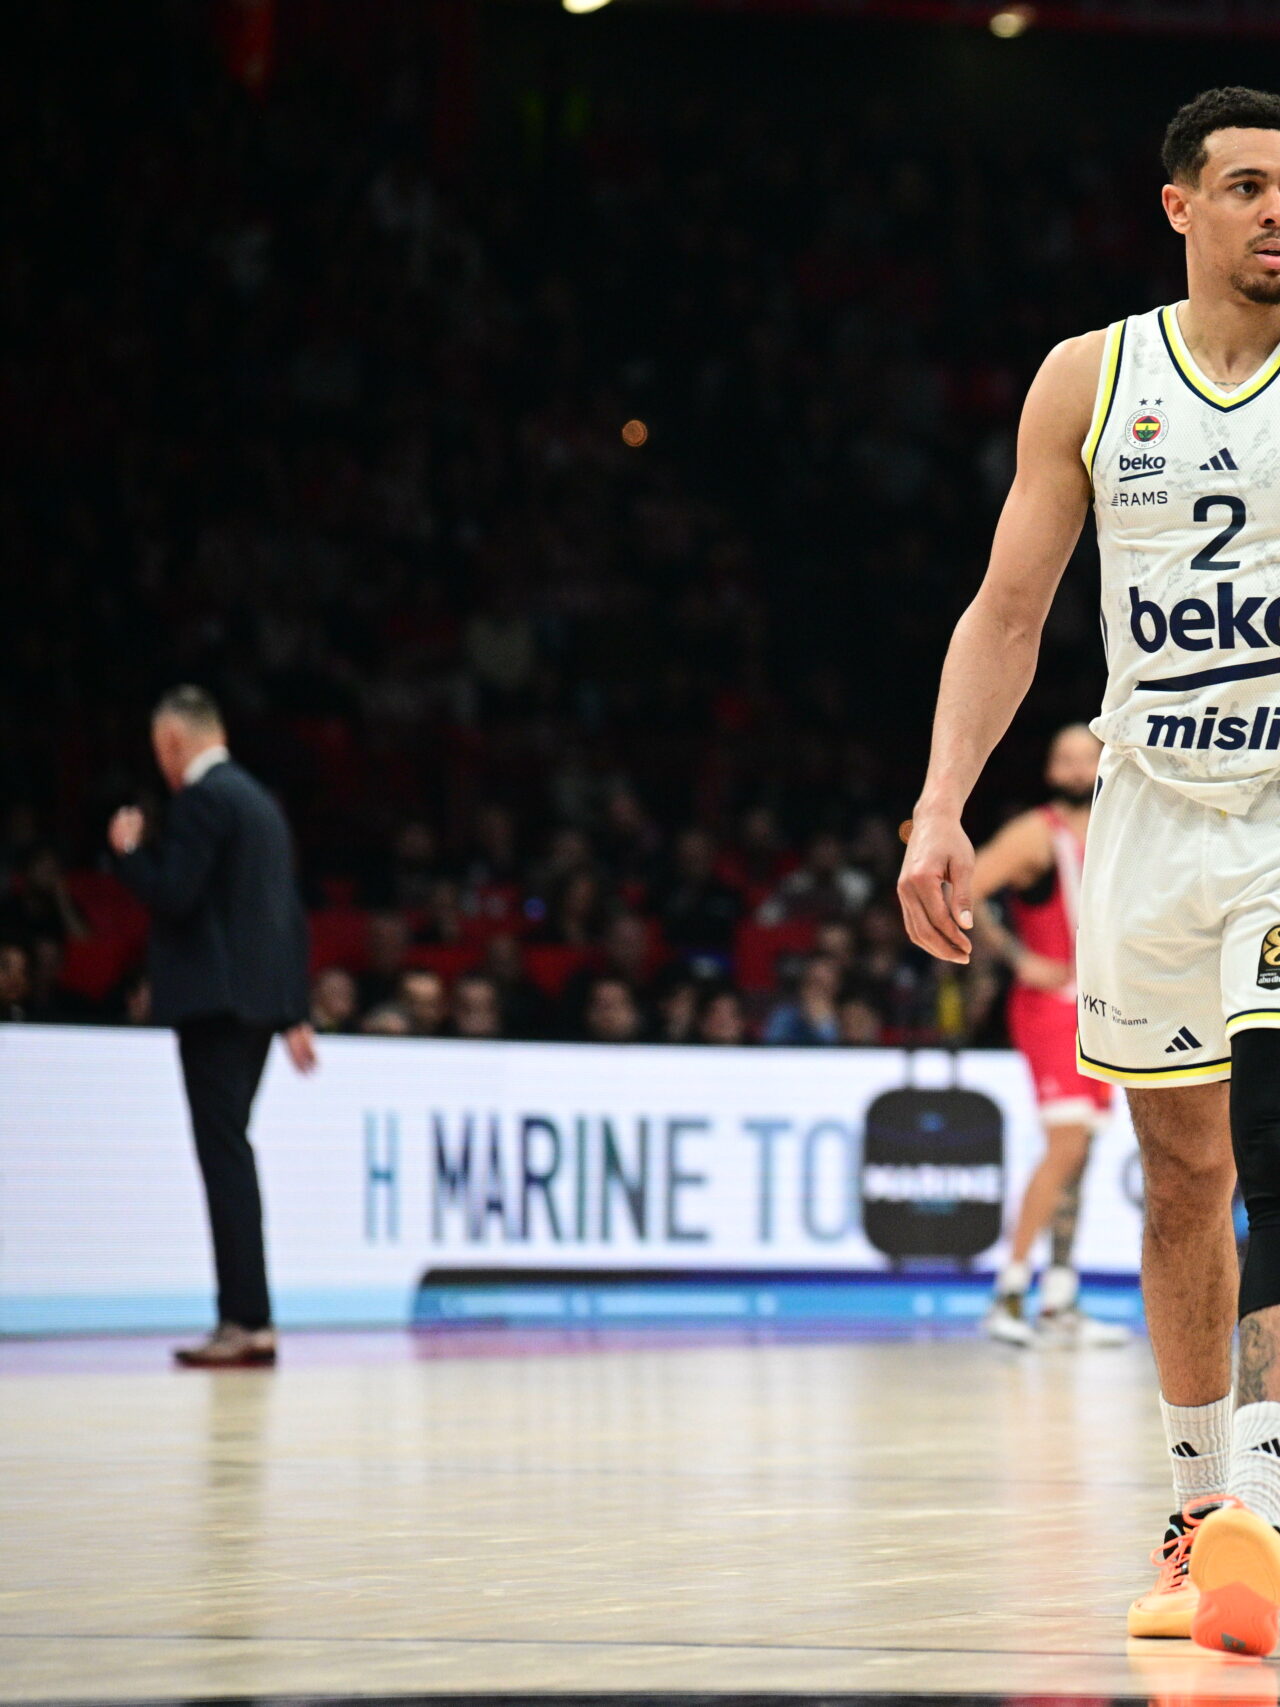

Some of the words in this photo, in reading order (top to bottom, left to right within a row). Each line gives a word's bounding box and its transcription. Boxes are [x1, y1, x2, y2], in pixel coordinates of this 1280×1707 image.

[1119, 453, 1166, 471] beko
[1119, 491, 1168, 506] RAMS
[1190, 494, 1247, 571] 2
[1082, 992, 1107, 1017] YKT
[431, 1112, 712, 1243] MARINE
